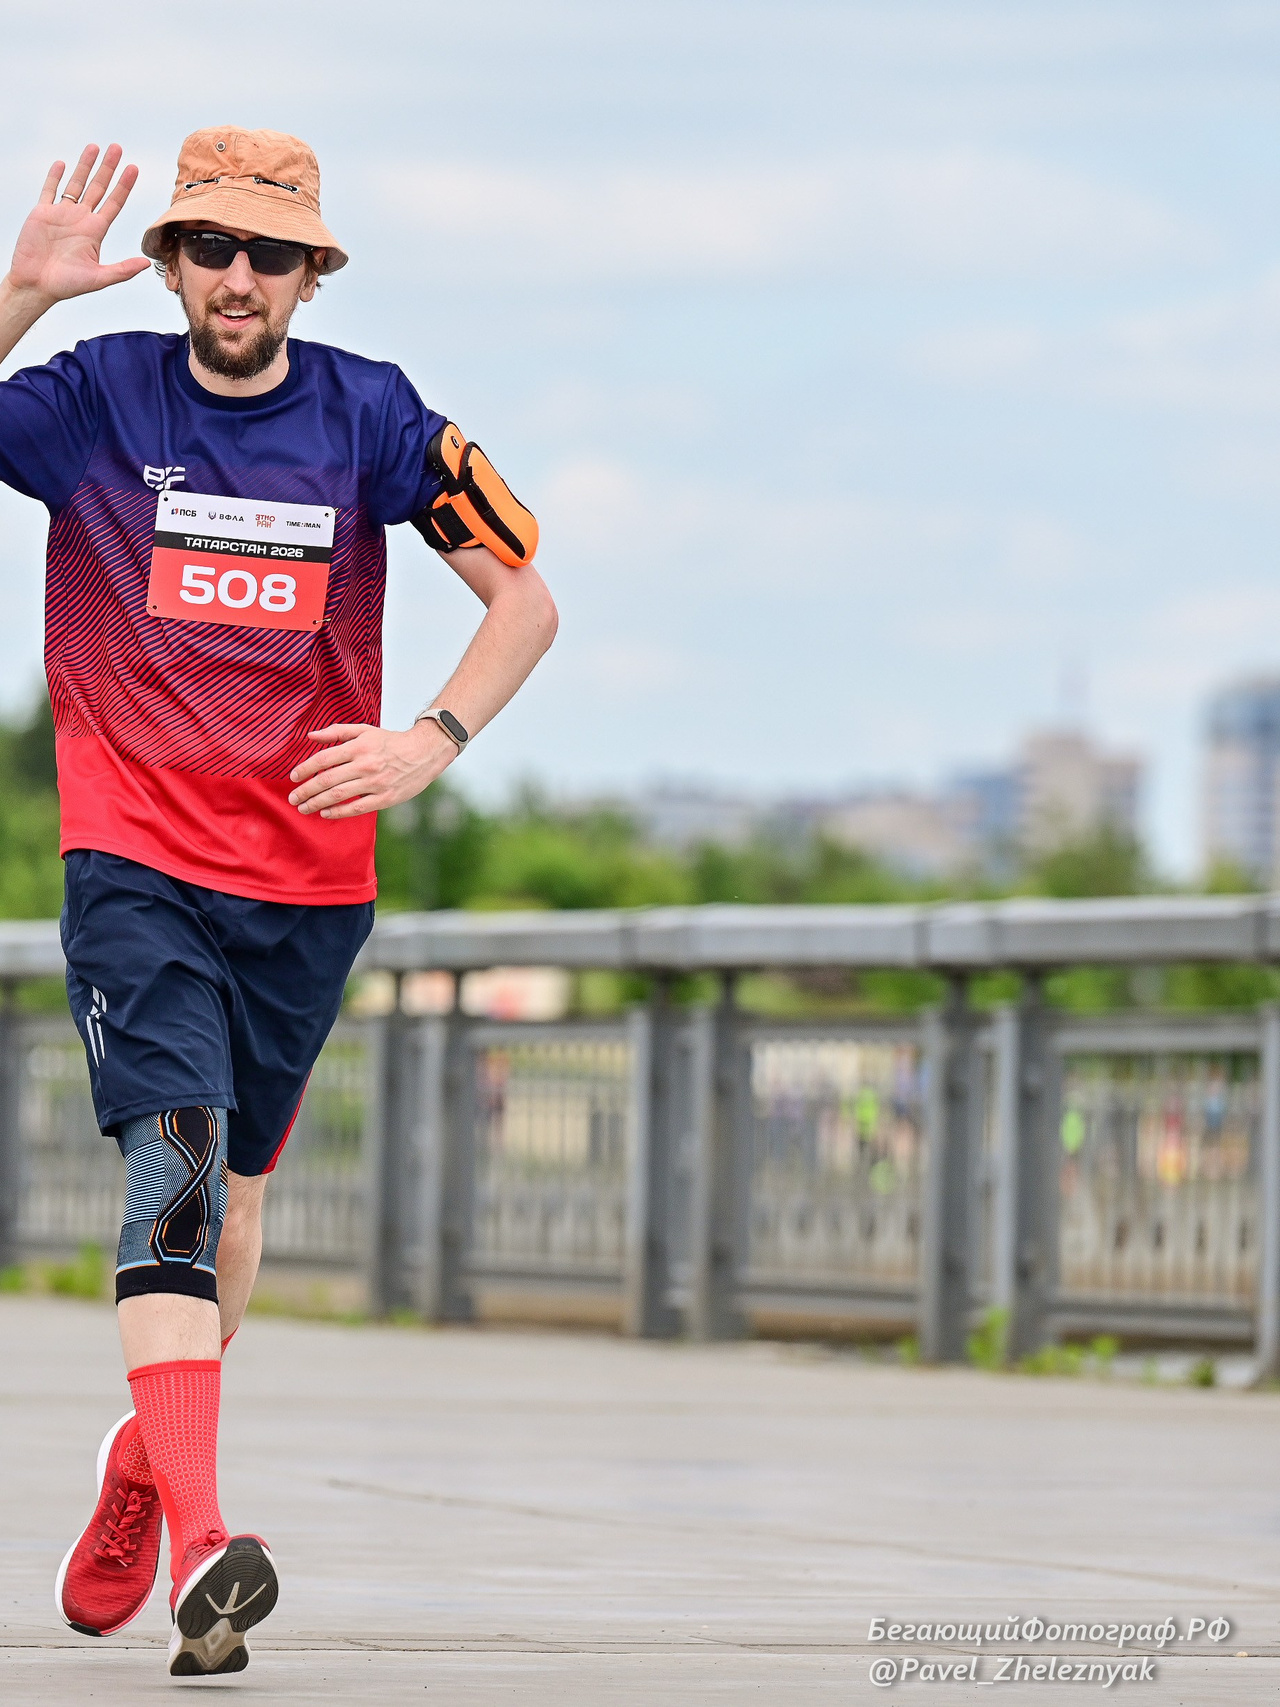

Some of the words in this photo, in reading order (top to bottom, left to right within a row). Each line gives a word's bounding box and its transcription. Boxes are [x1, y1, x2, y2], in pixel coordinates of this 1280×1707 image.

[179, 508, 197, 517] ПСБ
[219, 513, 244, 522] ВФЛА
[184, 536, 267, 555] ТАТАРСТАН
[270, 546, 304, 558] 2026
[179, 564, 297, 613] 508
